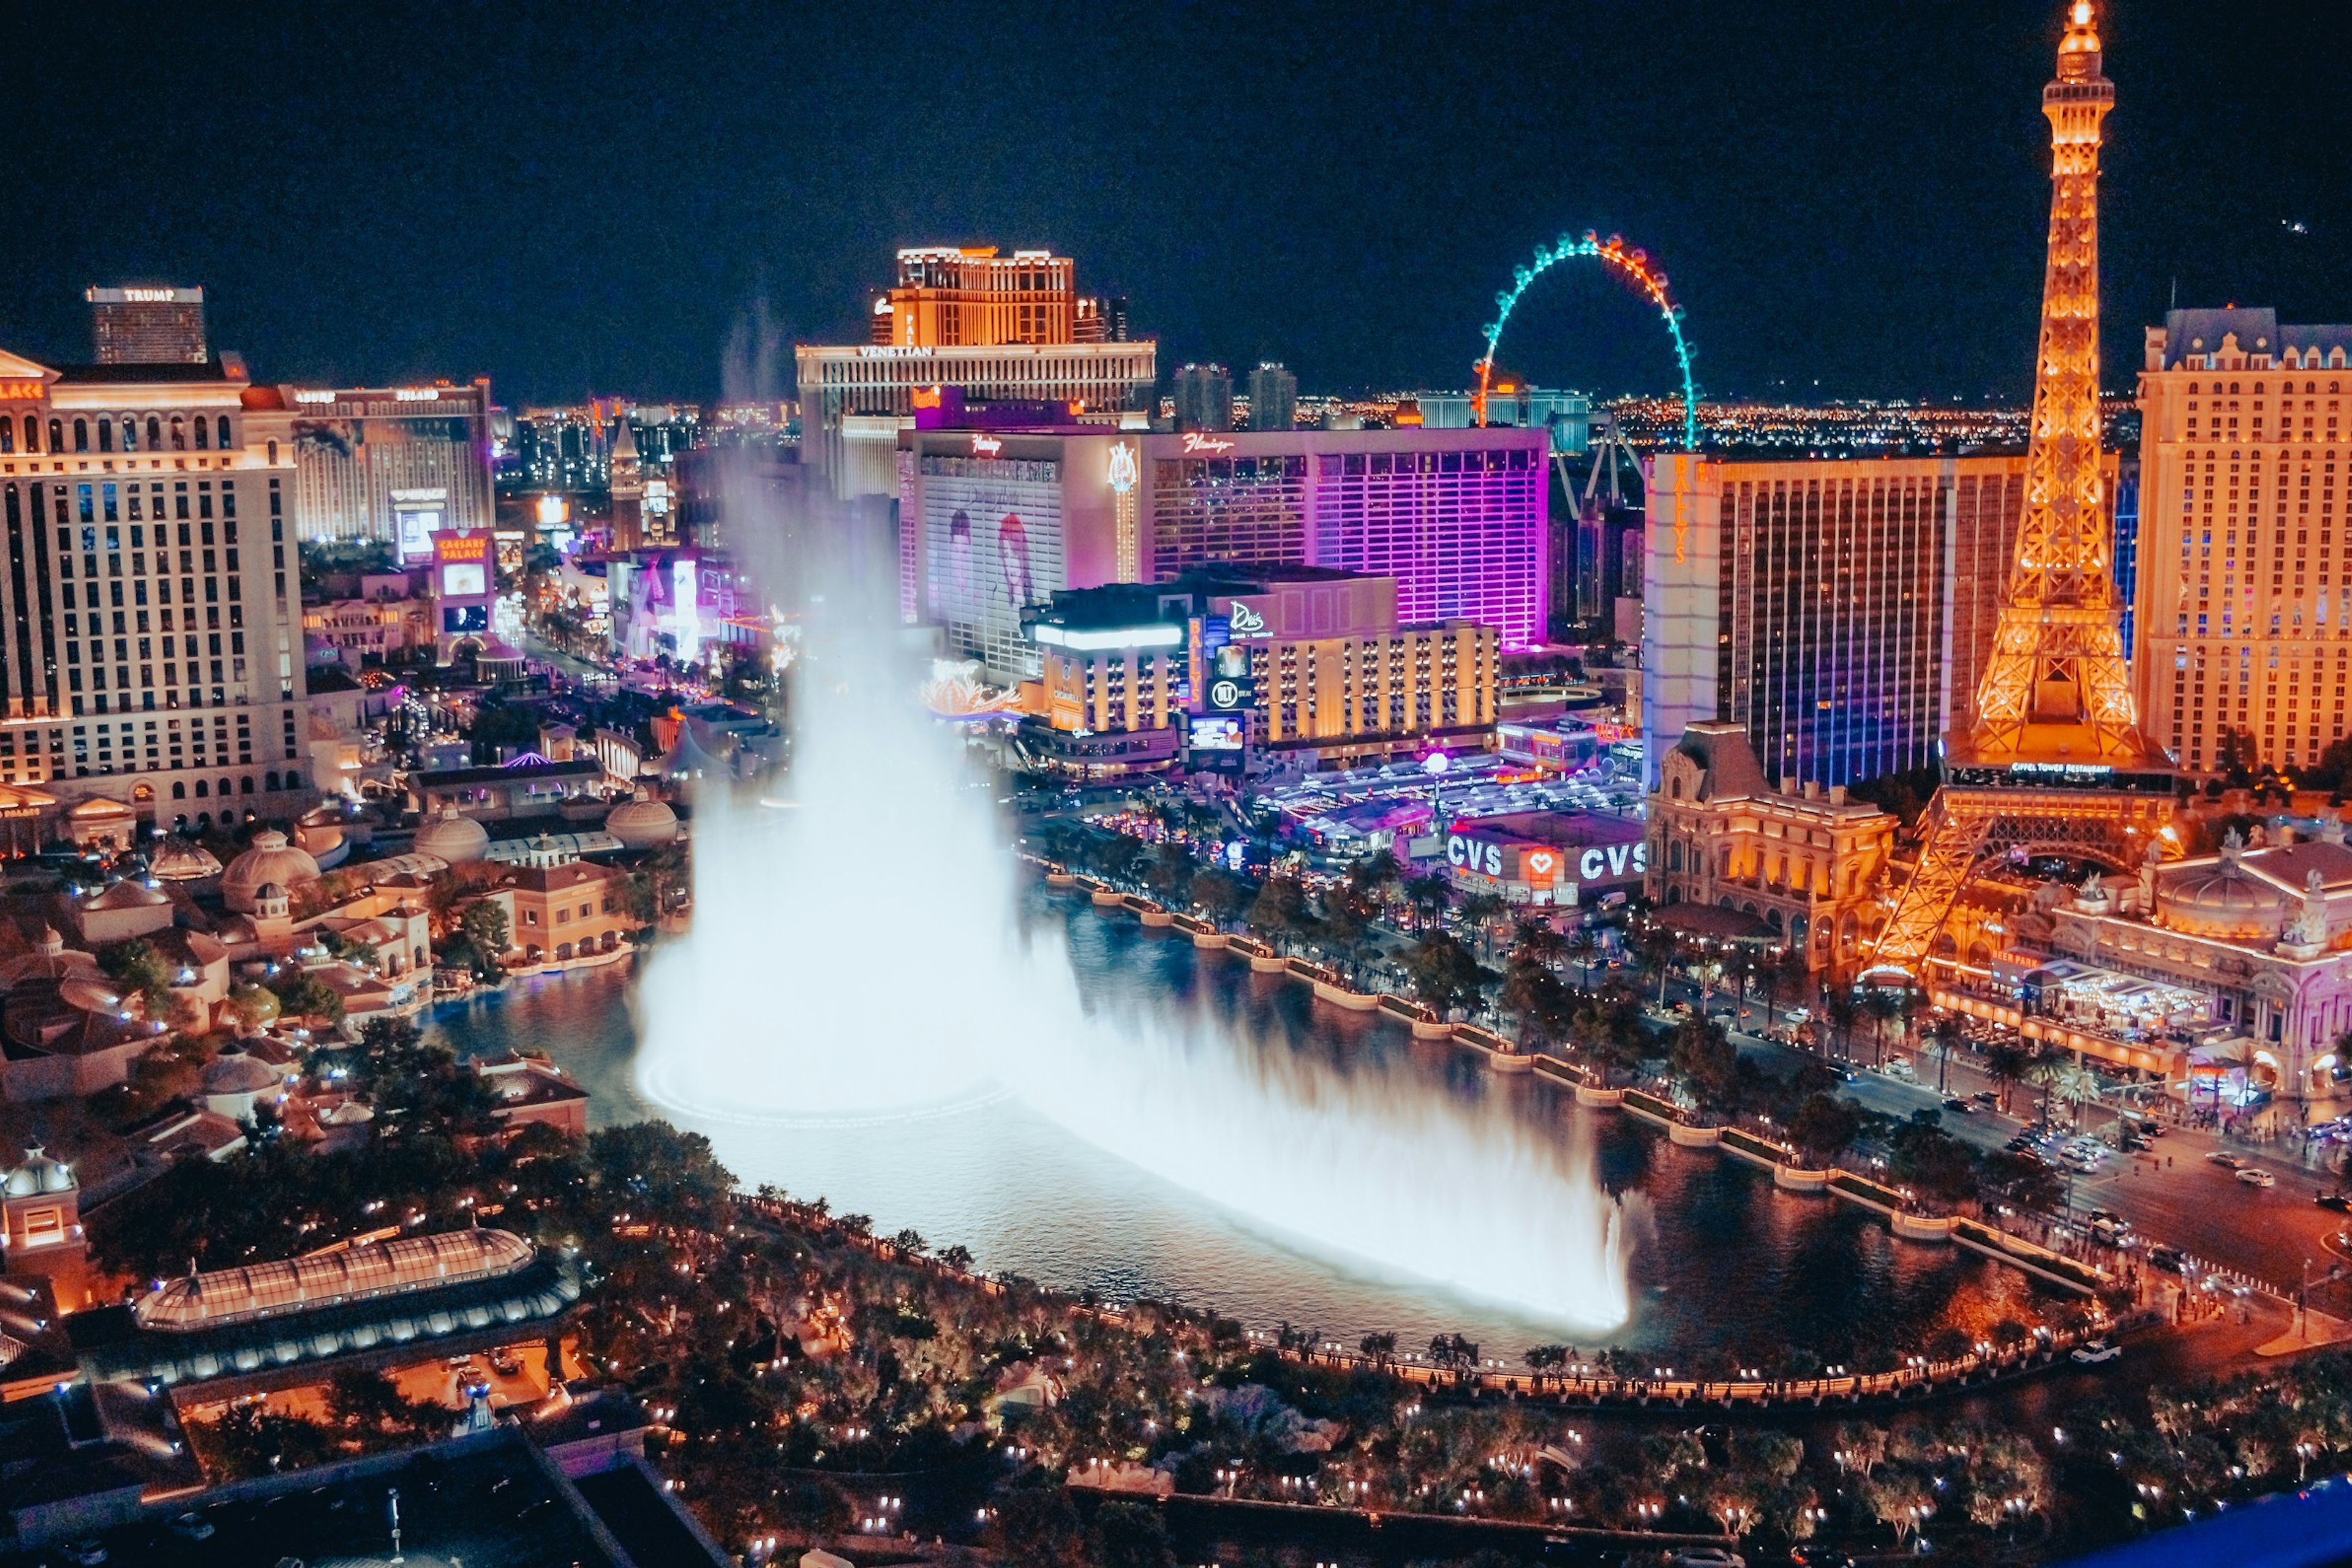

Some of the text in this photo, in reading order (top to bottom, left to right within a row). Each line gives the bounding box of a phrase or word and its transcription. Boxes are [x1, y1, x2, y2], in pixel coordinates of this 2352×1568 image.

[124, 289, 175, 301] TRUMP
[859, 345, 933, 357] VENETIAN
[1182, 432, 1234, 454] Flamingo
[438, 537, 486, 549] CAESARS
[440, 549, 483, 560] PALACE
[2038, 763, 2064, 772] TOWER
[2066, 764, 2111, 773] RESTAURANT
[1448, 835, 1501, 876] CVS
[1580, 843, 1646, 880] CVS
[1992, 950, 2039, 968] BEER PARK
